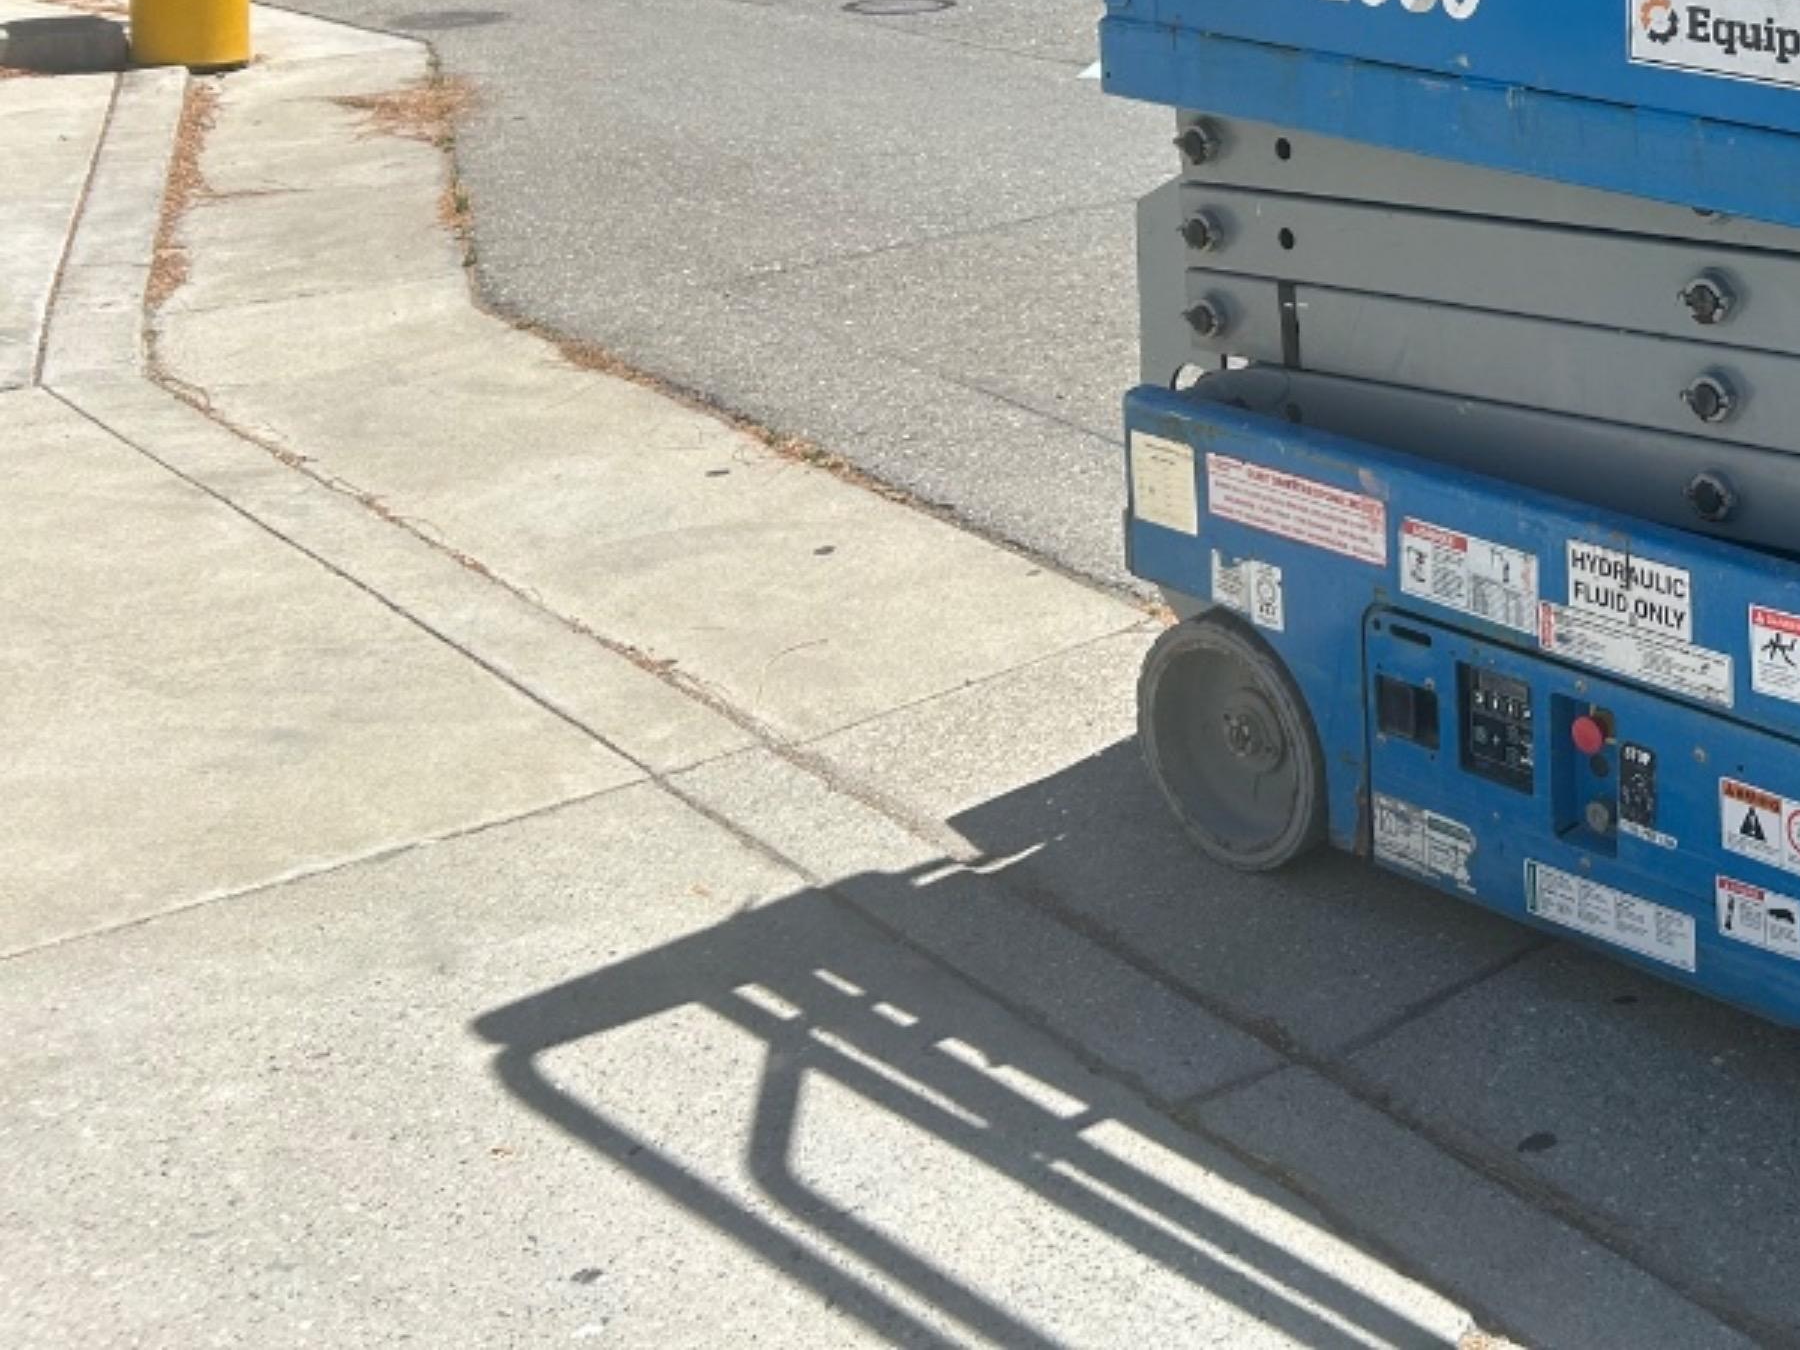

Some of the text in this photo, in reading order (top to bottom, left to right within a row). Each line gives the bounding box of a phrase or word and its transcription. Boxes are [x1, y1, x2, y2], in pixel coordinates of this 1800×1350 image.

[1572, 549, 1686, 599] HYDRAULIC
[1574, 581, 1686, 630] FLUID ONLY
